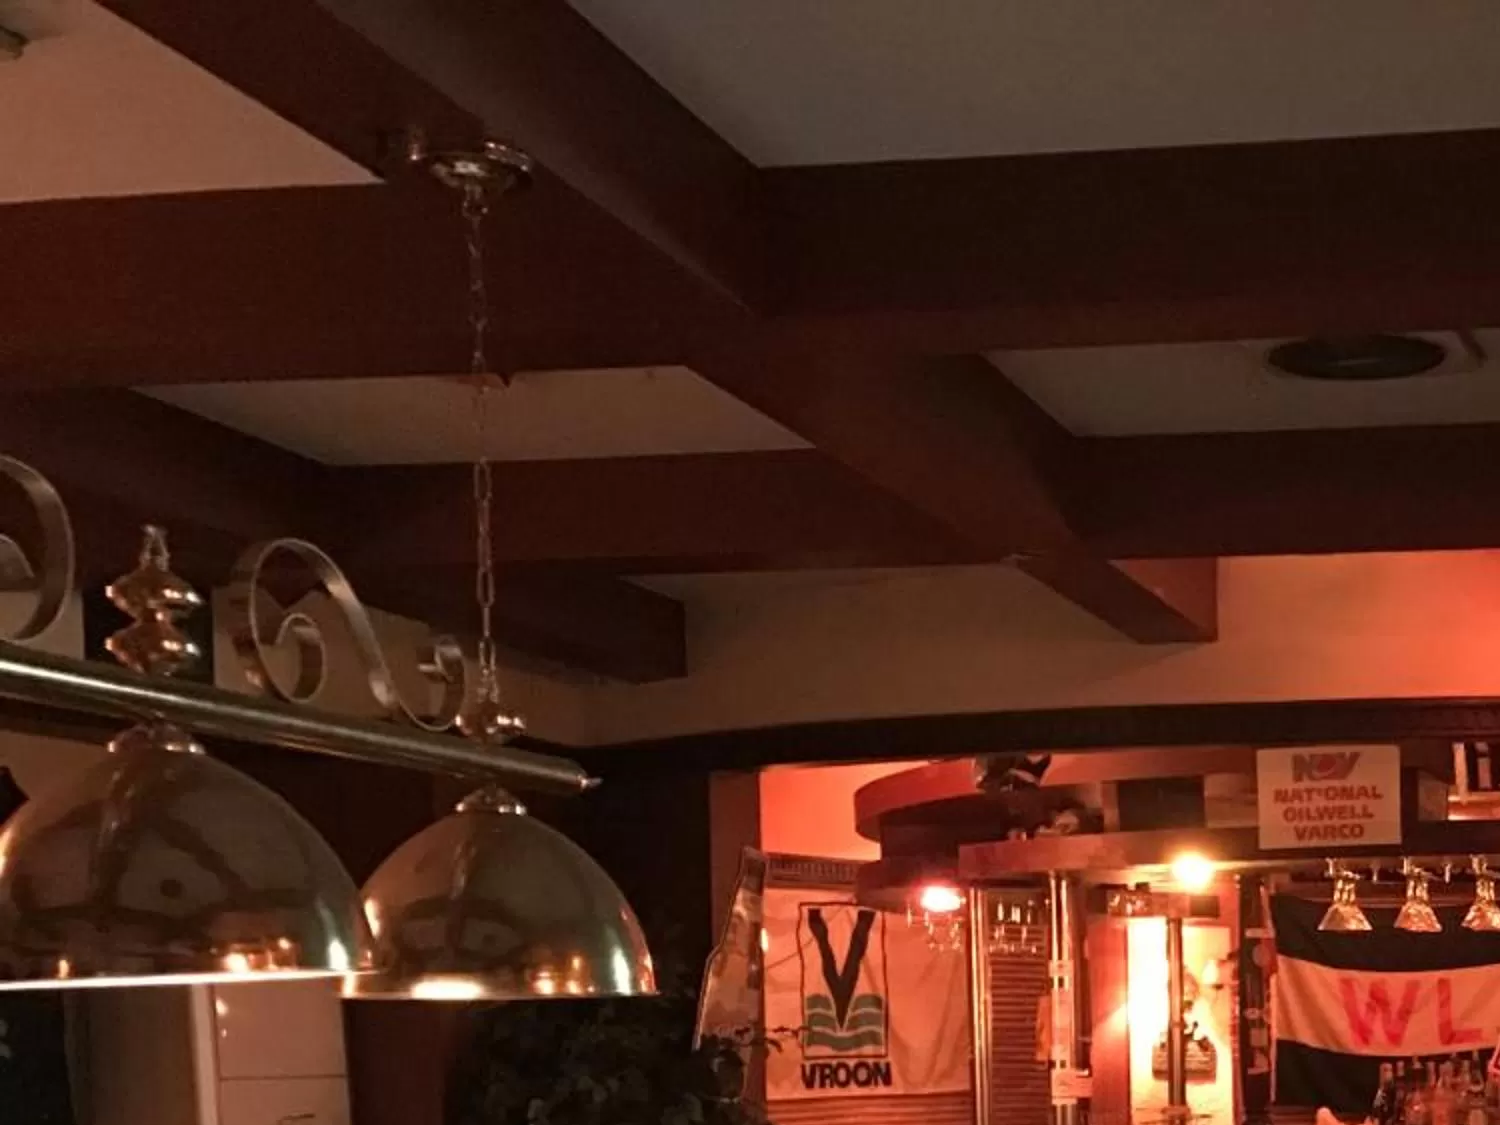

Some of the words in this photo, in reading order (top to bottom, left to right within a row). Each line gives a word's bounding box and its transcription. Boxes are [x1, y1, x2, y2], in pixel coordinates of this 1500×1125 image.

[1273, 785, 1384, 804] NATIONAL
[1282, 804, 1375, 824] OILWELL
[1293, 823, 1365, 842] VARCO
[801, 1060, 892, 1090] VROON
